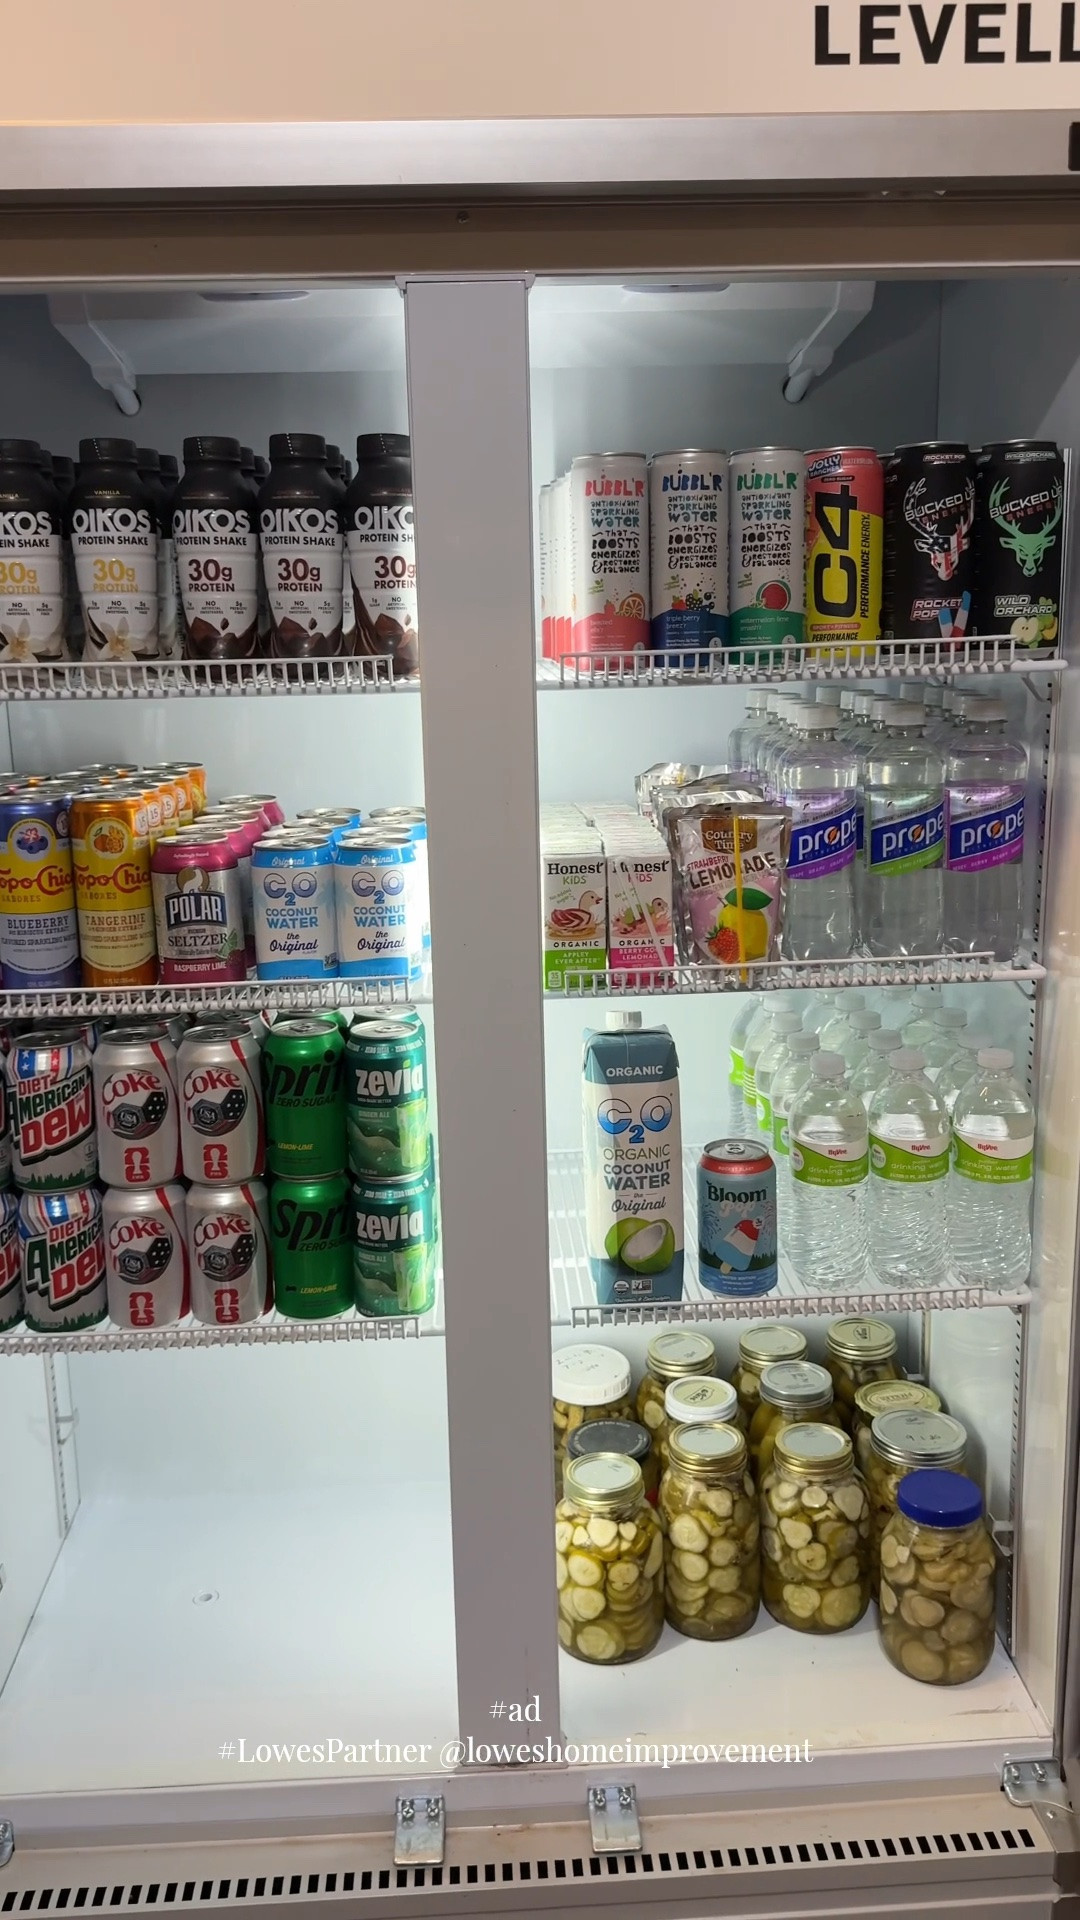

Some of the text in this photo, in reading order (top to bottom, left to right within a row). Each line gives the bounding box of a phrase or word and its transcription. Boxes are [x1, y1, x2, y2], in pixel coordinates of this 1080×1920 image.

[808, 453, 841, 471] JOLLY
[904, 494, 963, 522] BUCKED
[989, 492, 1050, 519] BUCKED
[73, 508, 151, 533] OIKOS
[172, 509, 250, 533] OIKOS
[260, 508, 339, 533] OIKOS
[18, 539, 50, 547] SHAKE
[78, 536, 148, 546] PROTEIN SHAKE
[176, 536, 247, 546] PROTEIN SHAKE
[265, 536, 336, 546] PROTEIN SHAKE
[360, 534, 399, 543] PROTEIN
[592, 537, 639, 549] BOOSTS
[669, 533, 717, 545] BOOSTS
[742, 531, 790, 543] BOOSTS
[813, 484, 858, 618] C4
[93, 559, 136, 582] 30g
[188, 559, 233, 581] 30g
[278, 558, 320, 582] 30g
[374, 556, 416, 579] 30g
[93, 584, 139, 592] PROTEIN
[189, 583, 235, 592] PROTEIN
[278, 583, 323, 592] PROTEIN
[860, 553, 871, 618] PERFORMANCE
[915, 599, 962, 609] ROCKET
[997, 596, 1030, 605] WILD
[913, 610, 940, 619] POP
[995, 605, 1053, 615] ORCHARD
[811, 632, 858, 642] PERFORMANCE
[150, 808, 158, 820] 15
[547, 861, 604, 875] Honest
[686, 855, 729, 872] STRAWBERRY
[169, 895, 222, 925] POLAR
[265, 906, 319, 917] COCONUT
[353, 905, 406, 915] COCONUT
[7, 915, 69, 929] BLUEBERRY
[85, 913, 146, 926] TANGERINE
[266, 917, 319, 929] WATER
[354, 914, 406, 927] WATER
[168, 932, 229, 947] SELTZER
[357, 938, 406, 954] Original
[553, 940, 600, 948] ORGANIC
[619, 938, 666, 946] ORGANC
[269, 940, 318, 955] Original
[174, 961, 227, 972] RASPBERRY LIME
[606, 1065, 664, 1078] ORGANIC
[184, 1070, 241, 1100] Coke
[355, 1061, 424, 1097] zevia
[102, 1073, 162, 1105] Coke
[276, 1097, 300, 1108] ZERO
[278, 1142, 314, 1151] LEMON-LIME
[603, 1144, 670, 1161] ORGANIC
[603, 1159, 671, 1175] COCONUT
[808, 1167, 843, 1175] drinking
[891, 1163, 926, 1172] drinking
[604, 1172, 671, 1191] WATER
[706, 1180, 768, 1203] Bloom
[611, 1197, 667, 1215] Original
[356, 1208, 424, 1241] zevia
[109, 1220, 166, 1250] Coke
[194, 1217, 251, 1248] Coke
[300, 1241, 327, 1251] ZERO
[300, 1283, 338, 1294] LEMON-LIME
